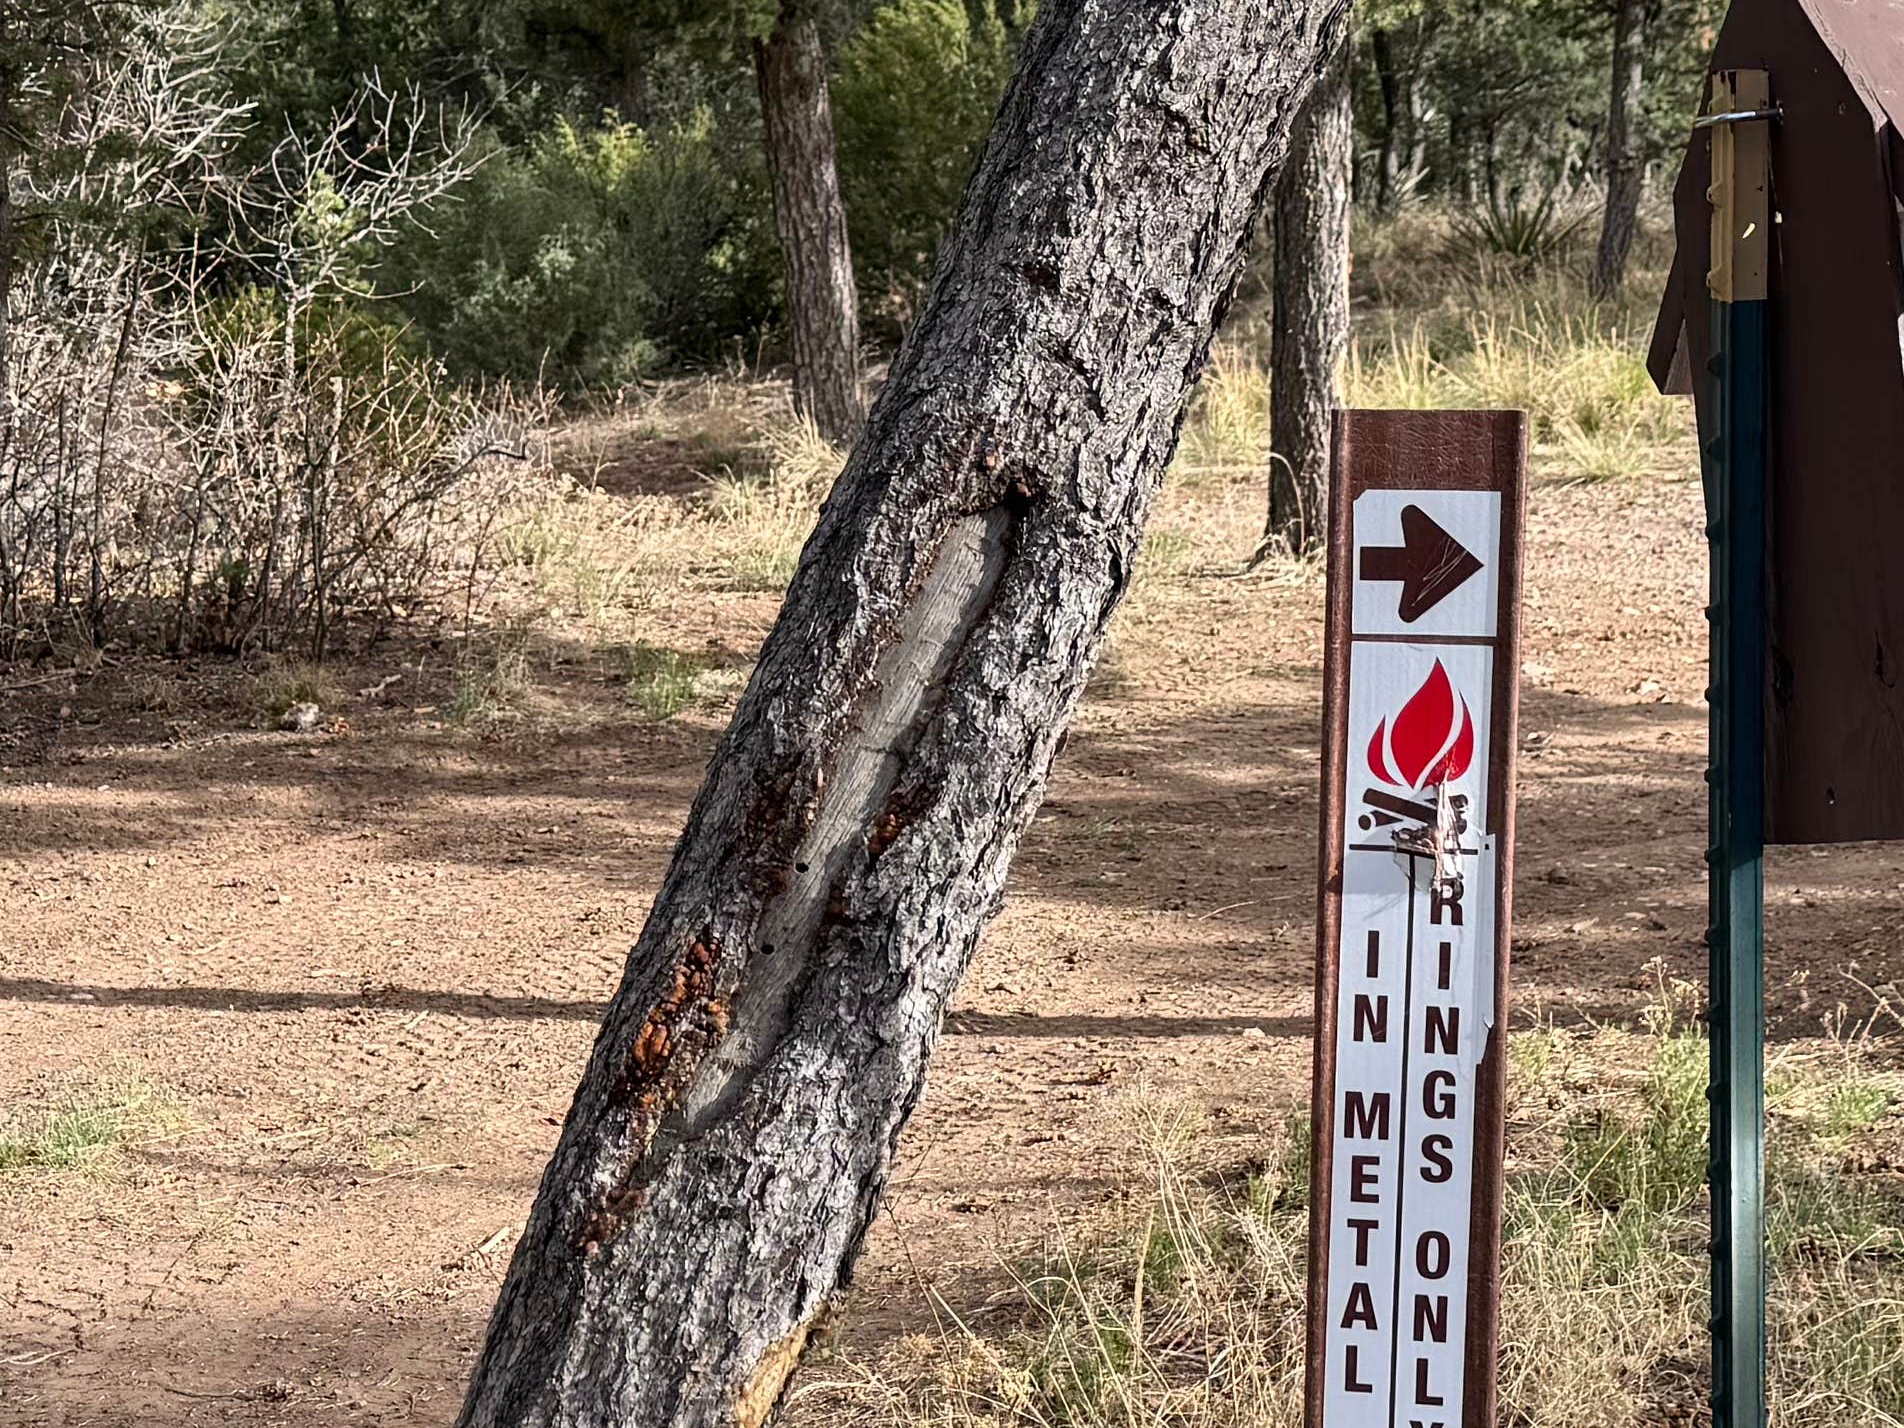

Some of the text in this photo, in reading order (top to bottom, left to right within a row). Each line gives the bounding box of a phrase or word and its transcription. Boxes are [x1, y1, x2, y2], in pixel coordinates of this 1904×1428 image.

[1340, 931, 1391, 1394] IN METAL
[1420, 876, 1465, 1184] RINGS
